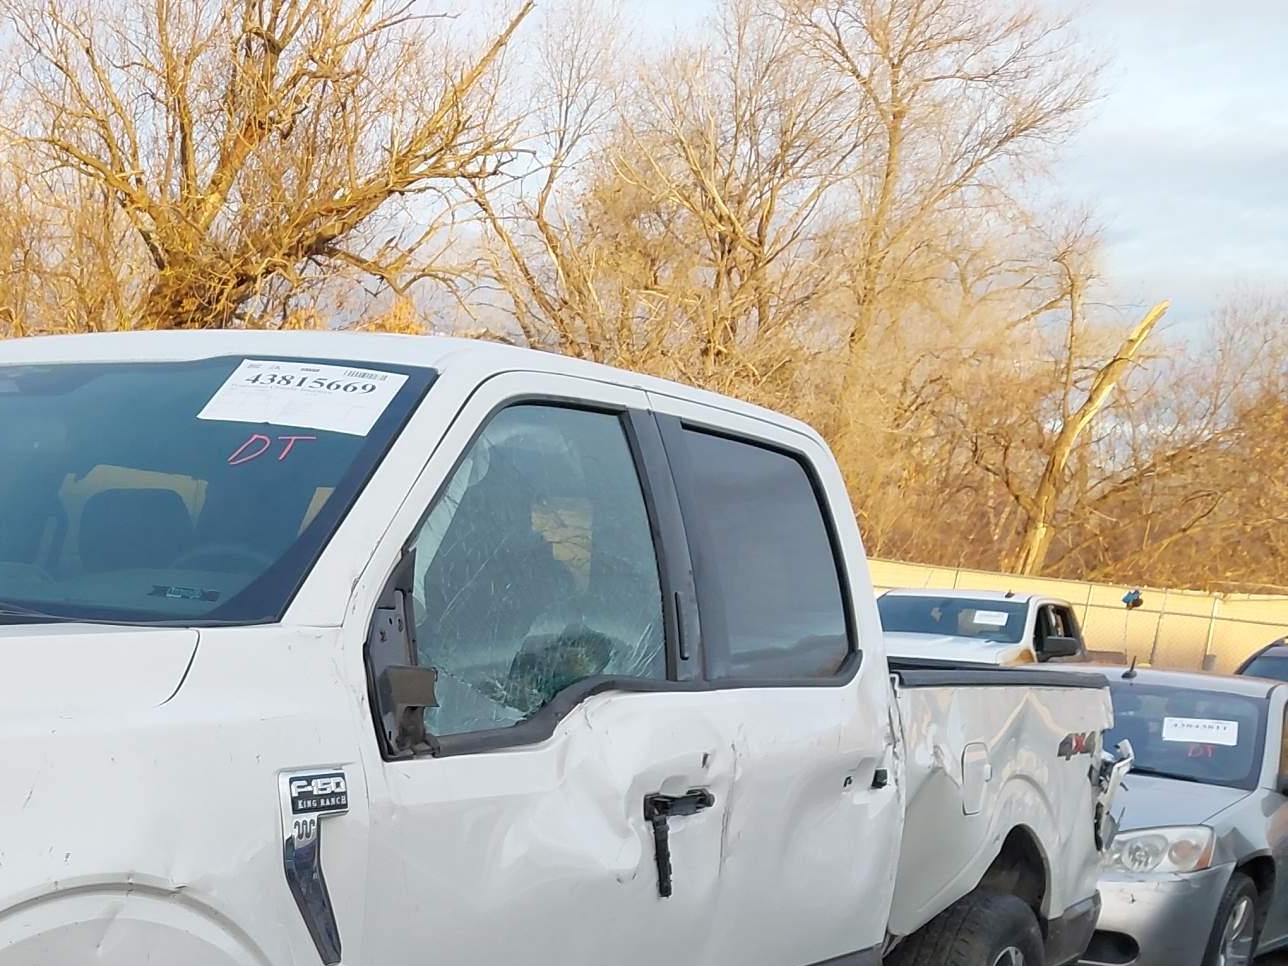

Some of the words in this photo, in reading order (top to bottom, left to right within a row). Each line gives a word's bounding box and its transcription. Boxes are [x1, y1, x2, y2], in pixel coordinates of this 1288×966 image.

[245, 373, 375, 395] 43815669
[291, 777, 346, 797] F-150
[298, 799, 317, 809] KING
[320, 795, 347, 806] RANCH
